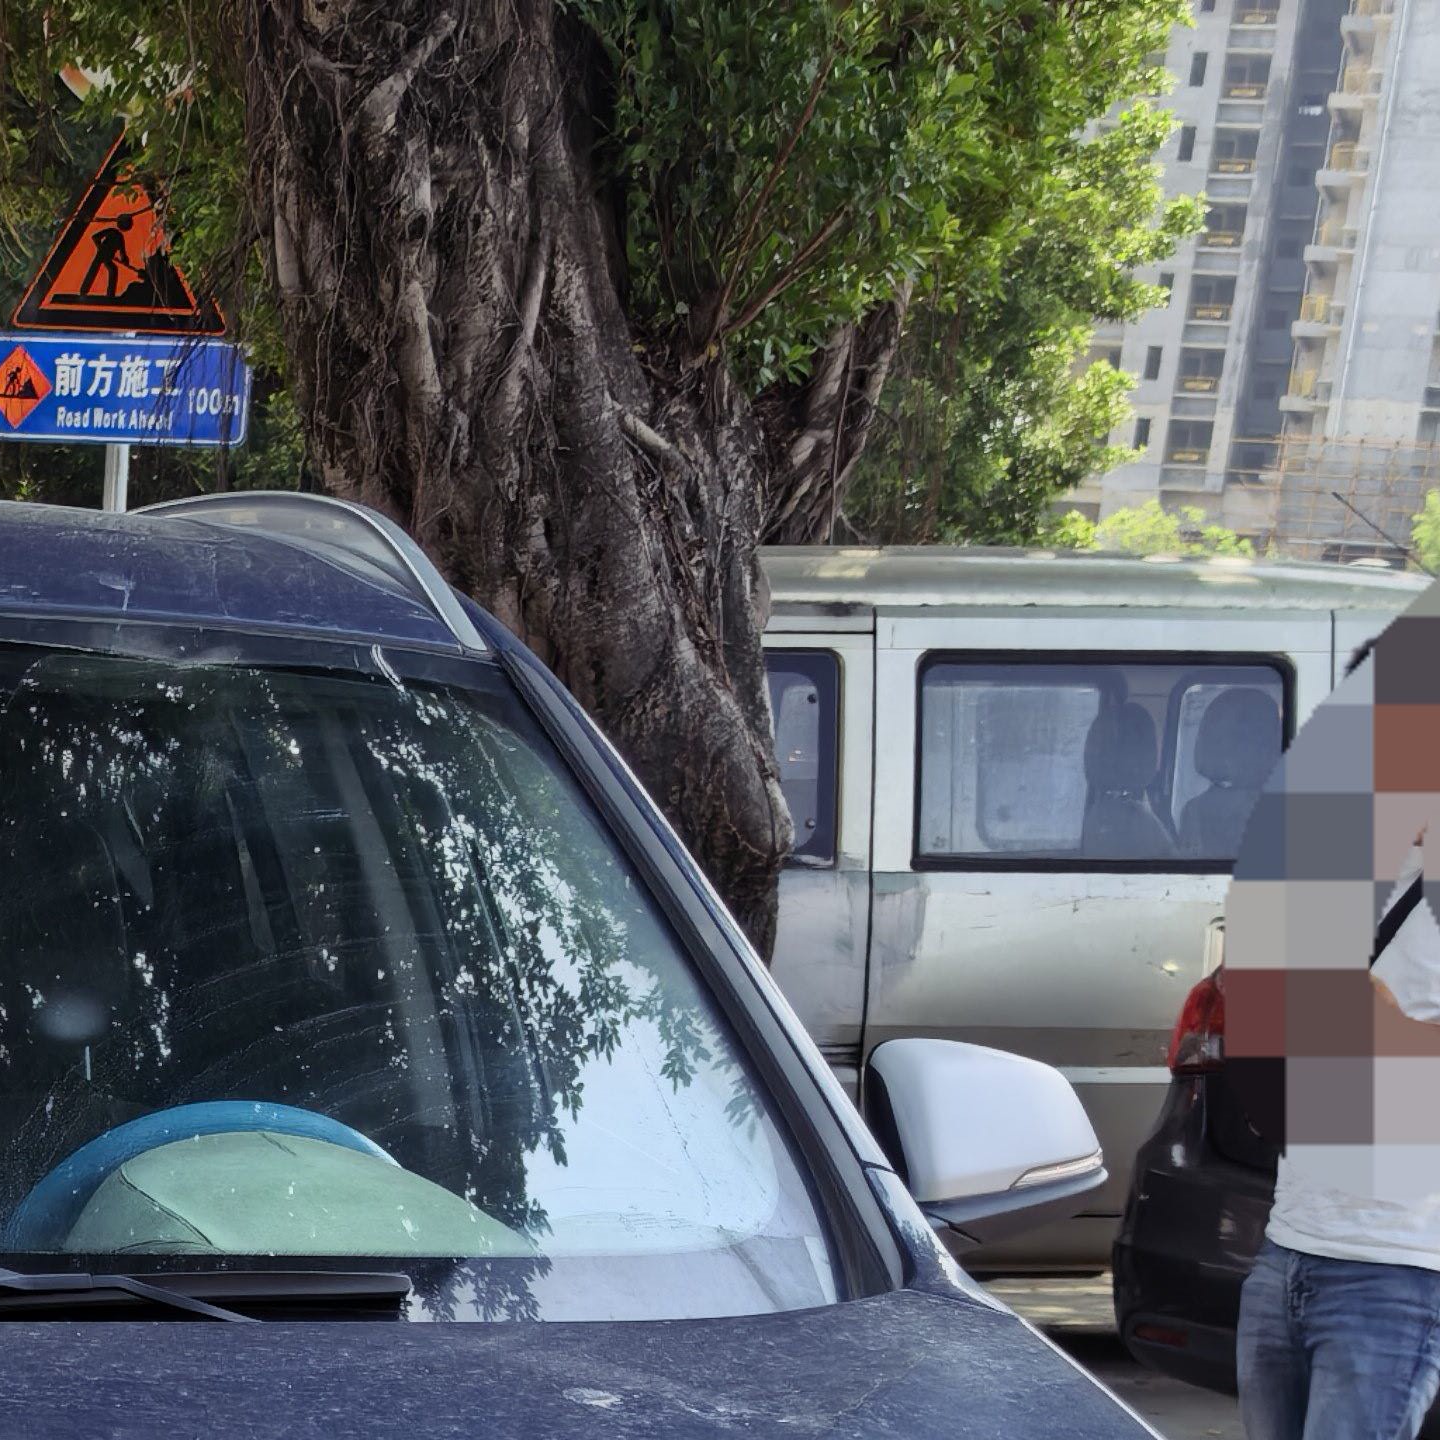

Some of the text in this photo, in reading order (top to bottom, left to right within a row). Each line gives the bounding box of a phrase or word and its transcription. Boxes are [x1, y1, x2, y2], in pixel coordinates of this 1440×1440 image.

[54, 352, 182, 398] 前方施工
[187, 386, 240, 416] 100m
[56, 405, 90, 429] Road
[93, 407, 126, 430] Work
